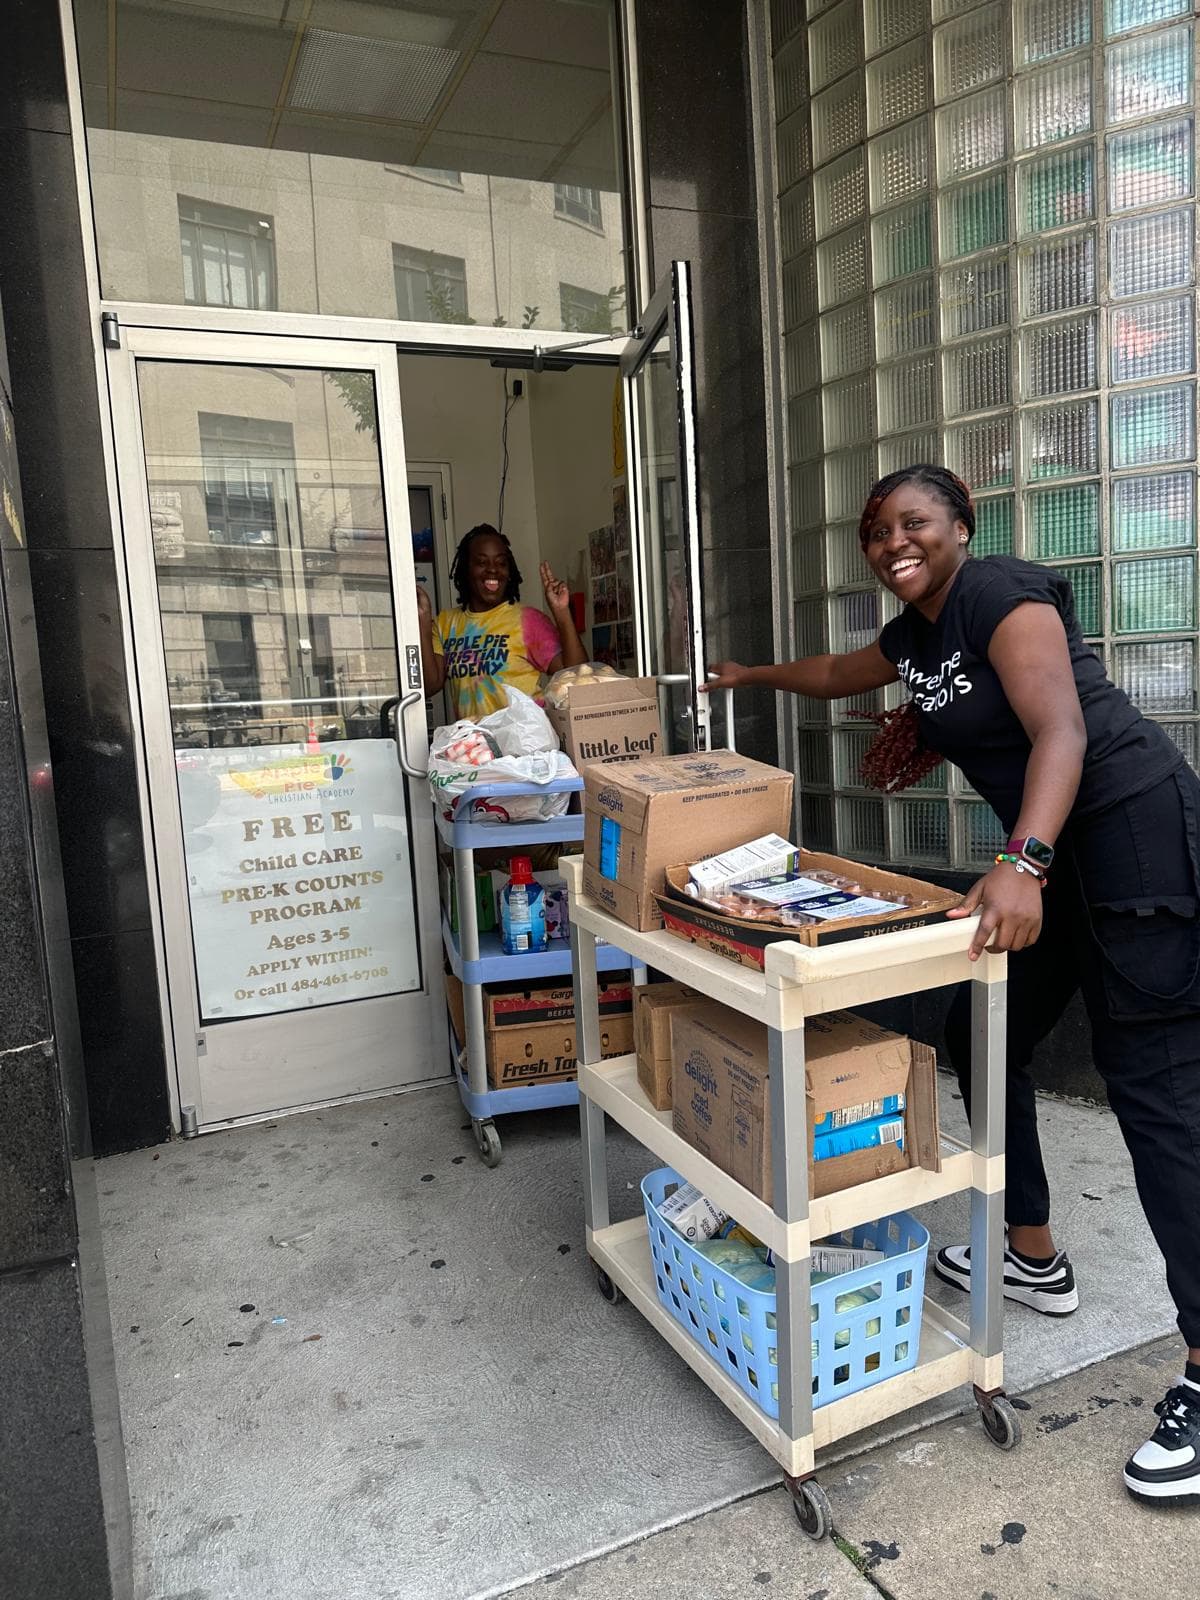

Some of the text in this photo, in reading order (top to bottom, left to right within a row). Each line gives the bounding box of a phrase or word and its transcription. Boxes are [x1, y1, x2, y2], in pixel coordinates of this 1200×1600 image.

[408, 648, 419, 687] PULL
[584, 711, 612, 720] REFRIGERATED
[612, 708, 630, 716] BETWEEN
[579, 739, 620, 760] little
[624, 732, 658, 754] leaf
[268, 787, 356, 804] CHRISTIAN ACADEMY
[284, 779, 316, 792] Pie
[682, 795, 694, 803] KEEP
[695, 790, 730, 802] REFRIGERATED
[742, 787, 751, 795] NOT
[597, 792, 624, 812] delight
[242, 809, 353, 842] FREE
[240, 846, 363, 873] Child CARE
[220, 870, 385, 905] PRE-K COUNTS
[249, 896, 362, 925] PROGRAM
[267, 926, 351, 951] Ages 3-5
[246, 947, 374, 977] APPLY WITHIN!
[234, 966, 389, 1001] Or call 484-461-6708
[551, 990, 573, 1000] Garg
[547, 1009, 575, 1018] BEEFS
[503, 1059, 549, 1078] Fresh
[683, 1060, 719, 1098] delight
[693, 1089, 709, 1110] iced
[691, 1100, 713, 1126] coffee
